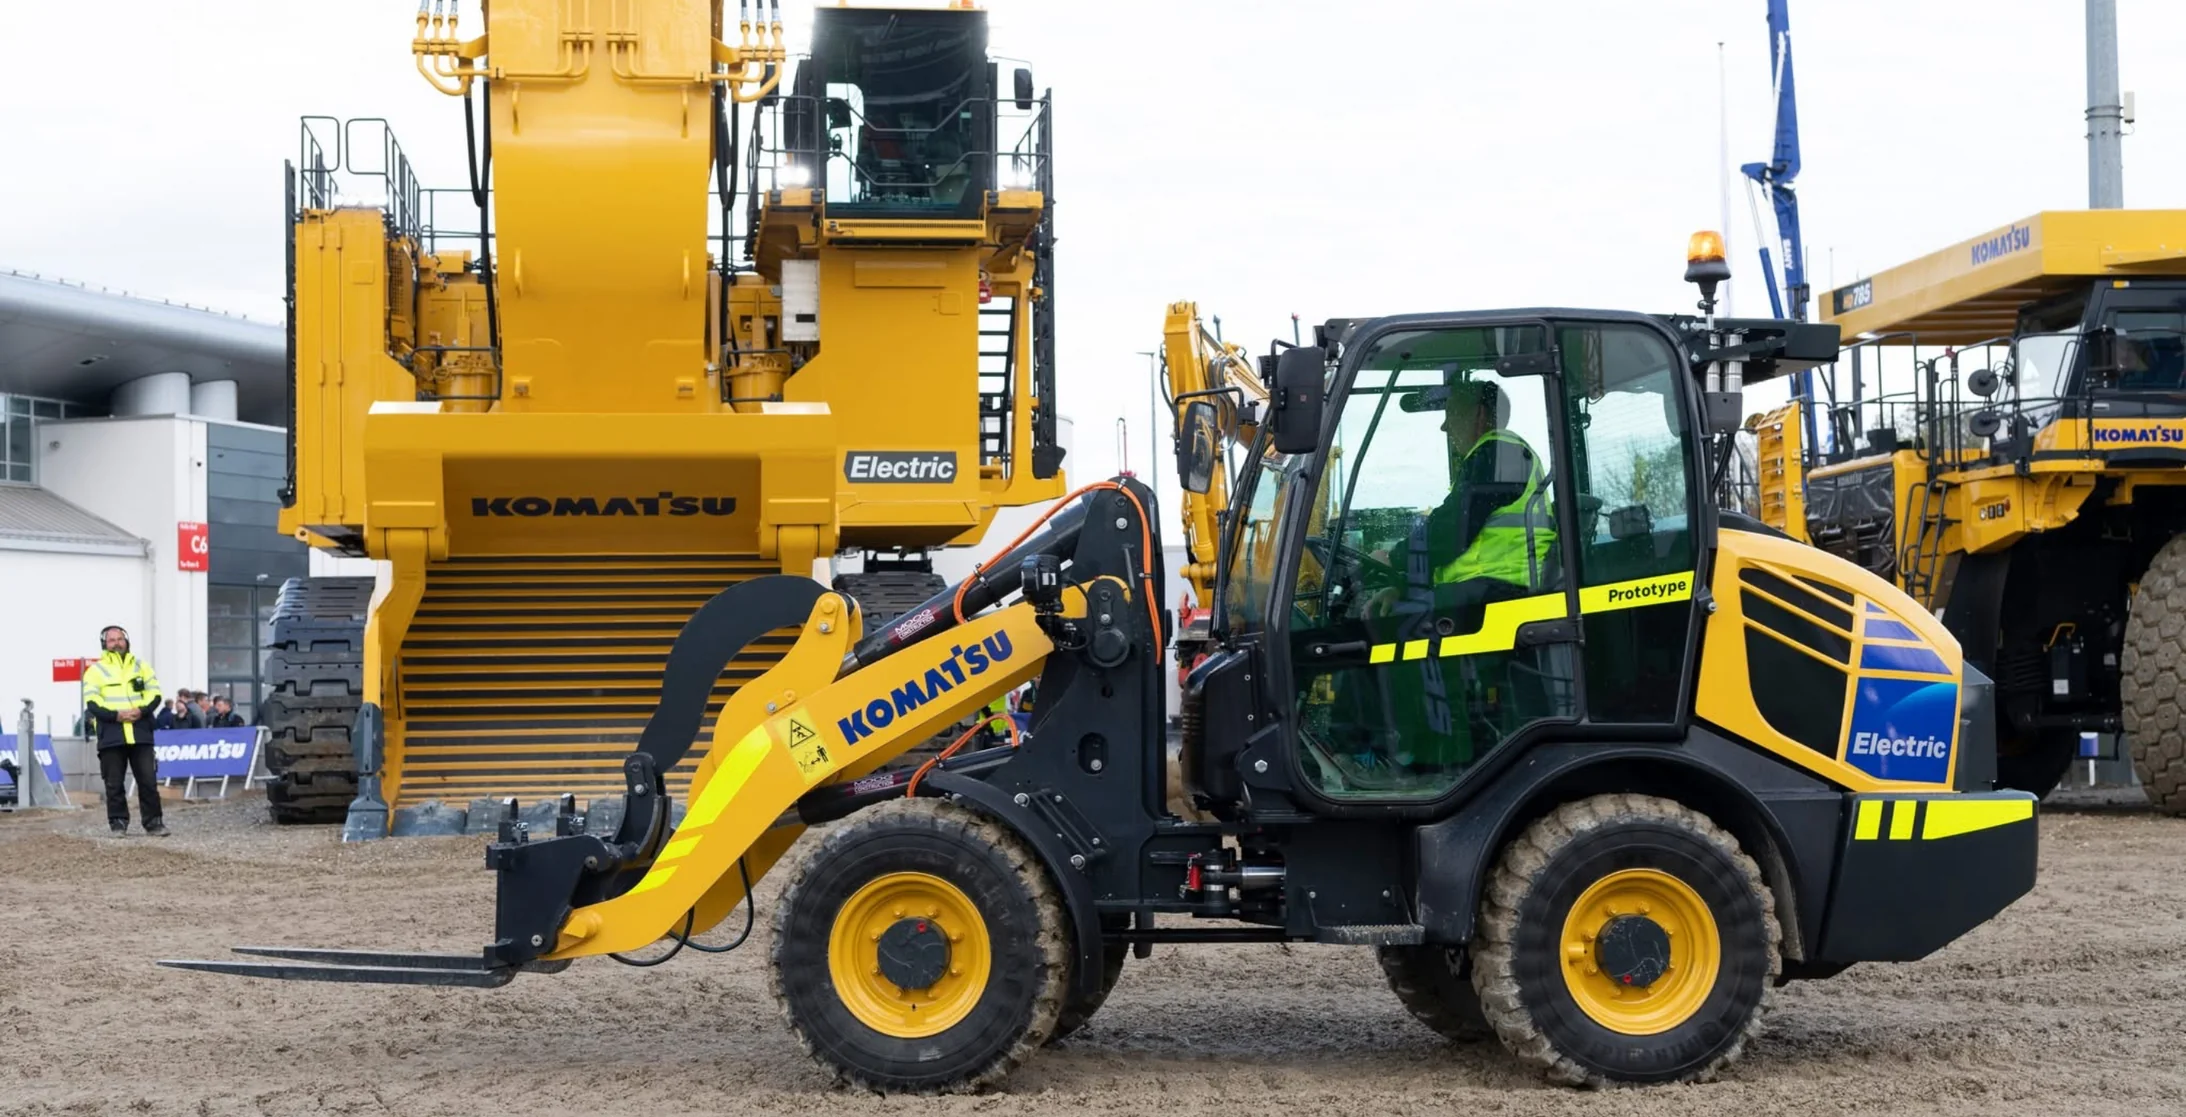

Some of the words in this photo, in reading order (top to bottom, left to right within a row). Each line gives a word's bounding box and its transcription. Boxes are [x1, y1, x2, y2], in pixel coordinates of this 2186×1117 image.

[1972, 224, 2030, 265] KOMATSU
[2094, 424, 2184, 442] KOMATSU
[850, 455, 954, 479] Electric
[471, 491, 738, 517] KOMATSU
[191, 535, 208, 554] C6
[1608, 581, 1687, 603] Prototype
[895, 608, 931, 635] MOOG
[837, 629, 1013, 746] KOMATSU
[1852, 731, 1947, 759] Electric
